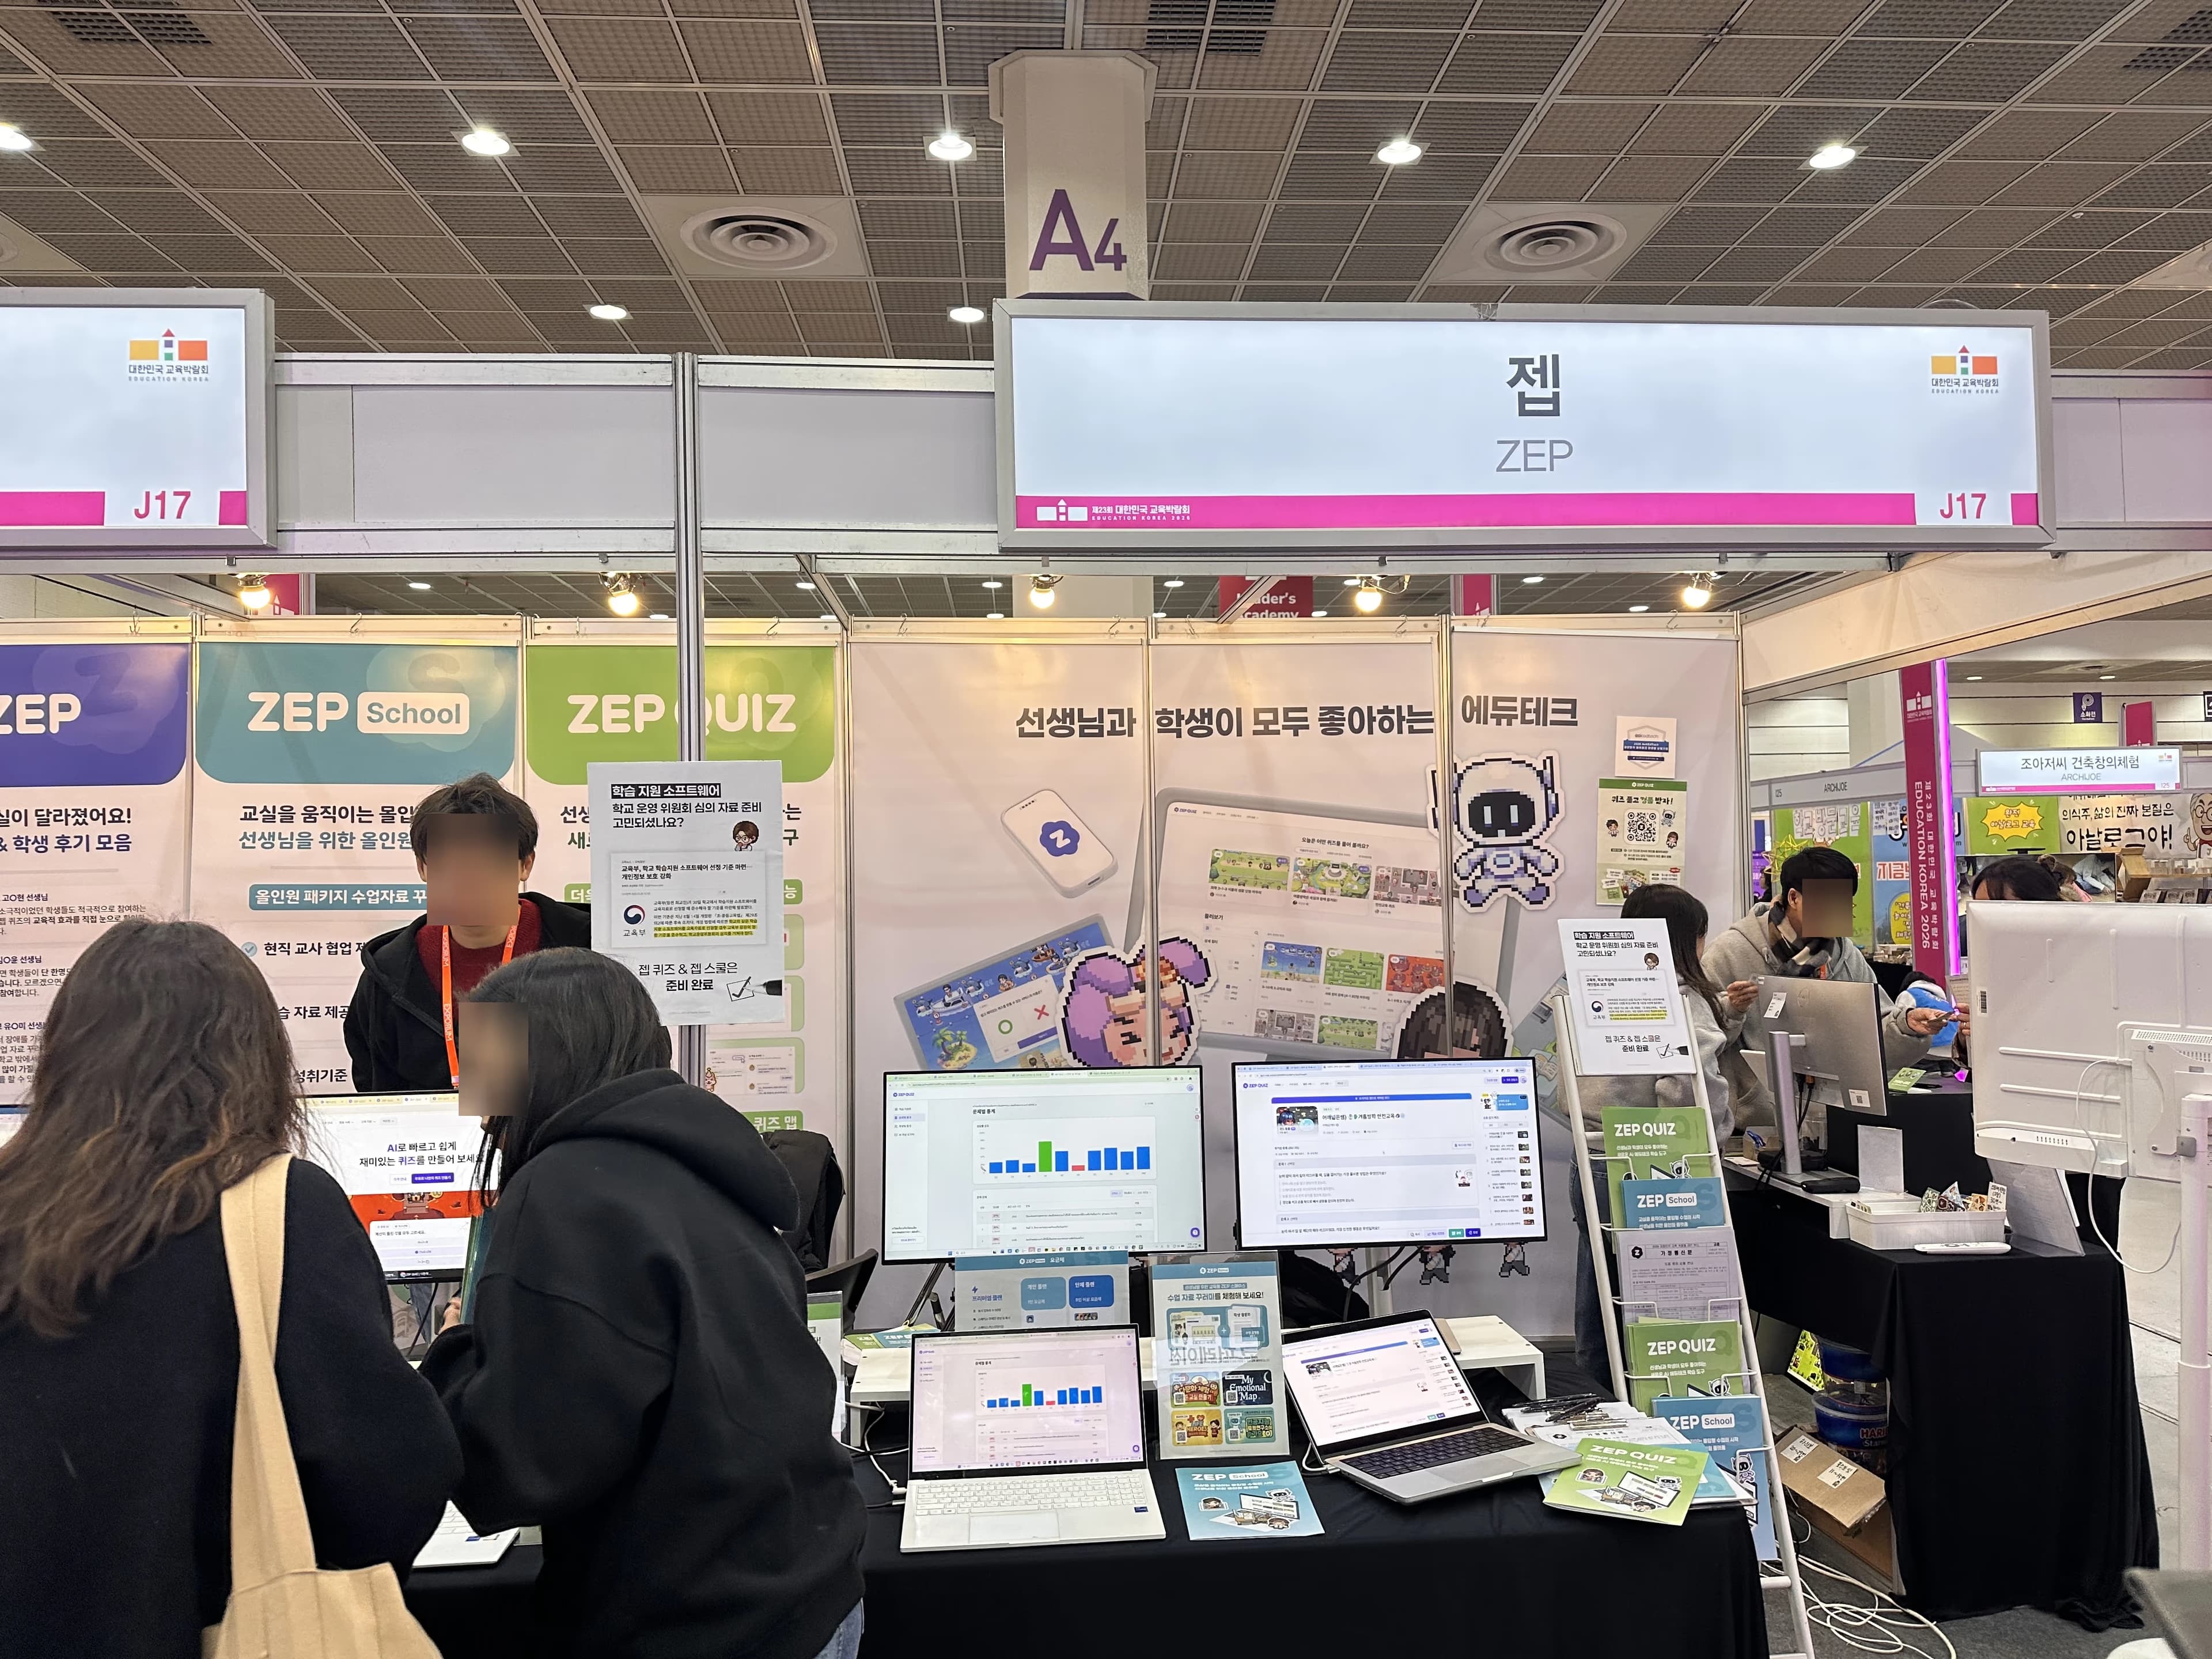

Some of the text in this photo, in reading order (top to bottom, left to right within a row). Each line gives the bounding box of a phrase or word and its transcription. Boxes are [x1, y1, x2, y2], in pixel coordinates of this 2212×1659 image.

[1029, 189, 1127, 271] A4
[128, 365, 209, 374] 대한민국 교육박람회
[1505, 353, 1560, 416] 젭
[1931, 378, 1999, 388] 대한민국 교육박람회
[1495, 440, 1574, 472] ZEP
[134, 490, 191, 520] J17
[1092, 505, 1190, 514] 제23회 대한민국 교육박람회
[1940, 493, 1987, 520] J17
[247, 691, 461, 732] ZEP School
[567, 694, 665, 733] ZEP
[1015, 695, 1579, 738] 선생님과 학생이 모두 좋아하는 에듀테크
[2021, 756, 2140, 770] 조아저씨 건축창의체험
[2061, 773, 2102, 781] ARCHIJOE
[612, 785, 720, 798] 학습 지원 소프트웨어
[239, 805, 375, 824] 교실을 움직이는
[612, 801, 762, 814] 학교 운영 위원회 심의 자료 준비
[2116, 802, 2175, 818] 진짜 본질은
[35, 808, 131, 827] 달라졌어요!
[612, 817, 684, 829] 고민되셨나요?
[13, 834, 132, 854] 학생 후기 모음
[238, 831, 314, 850] 선생님을
[318, 831, 356, 850] 위한
[2066, 824, 2172, 851] 아날로그야!
[1915, 781, 1930, 949] EDUCATION KOREA 2026
[26, 893, 48, 902] 선생님
[255, 889, 409, 904] 올인원 패키지 수업자료
[46, 906, 76, 914] 학생들도
[78, 905, 115, 914] 적극적으로
[118, 904, 146, 913] 참여하는
[9, 916, 31, 925] 퀴즈의
[33, 916, 55, 924] 교육적
[58, 915, 79, 923] 효과를
[82, 915, 97, 923] 직접
[99, 915, 121, 923] 눈으로
[623, 929, 646, 937] 교육부
[264, 941, 352, 956] 현직 교사 협업
[20, 956, 42, 964] 선생님
[9, 968, 49, 977] 학생들이 단
[638, 962, 738, 976] 젭 퀴즈 & 젭 스쿨은
[1, 988, 40, 997] 참여합니다.
[665, 979, 714, 992] 준비 완료
[294, 1006, 321, 1019] 자료
[443, 1003, 452, 1041] EXPORUM
[753, 1116, 797, 1131] 퀴즈 맵
[1614, 1123, 1677, 1137] ZEP QUIZ
[387, 1141, 457, 1152] AI로 빠르고 쉽게
[359, 1154, 454, 1167] 재미있는 퀴즈를 만들어
[1637, 1194, 1695, 1208] ZEP School
[1168, 1294, 1180, 1302] 수업
[1222, 1292, 1241, 1300] 체험해
[1243, 1291, 1264, 1300] 보세요!
[1647, 1338, 1717, 1355] ZEP QUIZ
[1229, 1382, 1266, 1392] Emotional
[1242, 1375, 1253, 1385] My
[1240, 1392, 1257, 1402] Map
[1670, 1415, 1733, 1430] ZEP School
[1590, 1445, 1629, 1456] ZEP
[1629, 1451, 1678, 1464] QUIZ
[1191, 1473, 1227, 1481] ZEP
